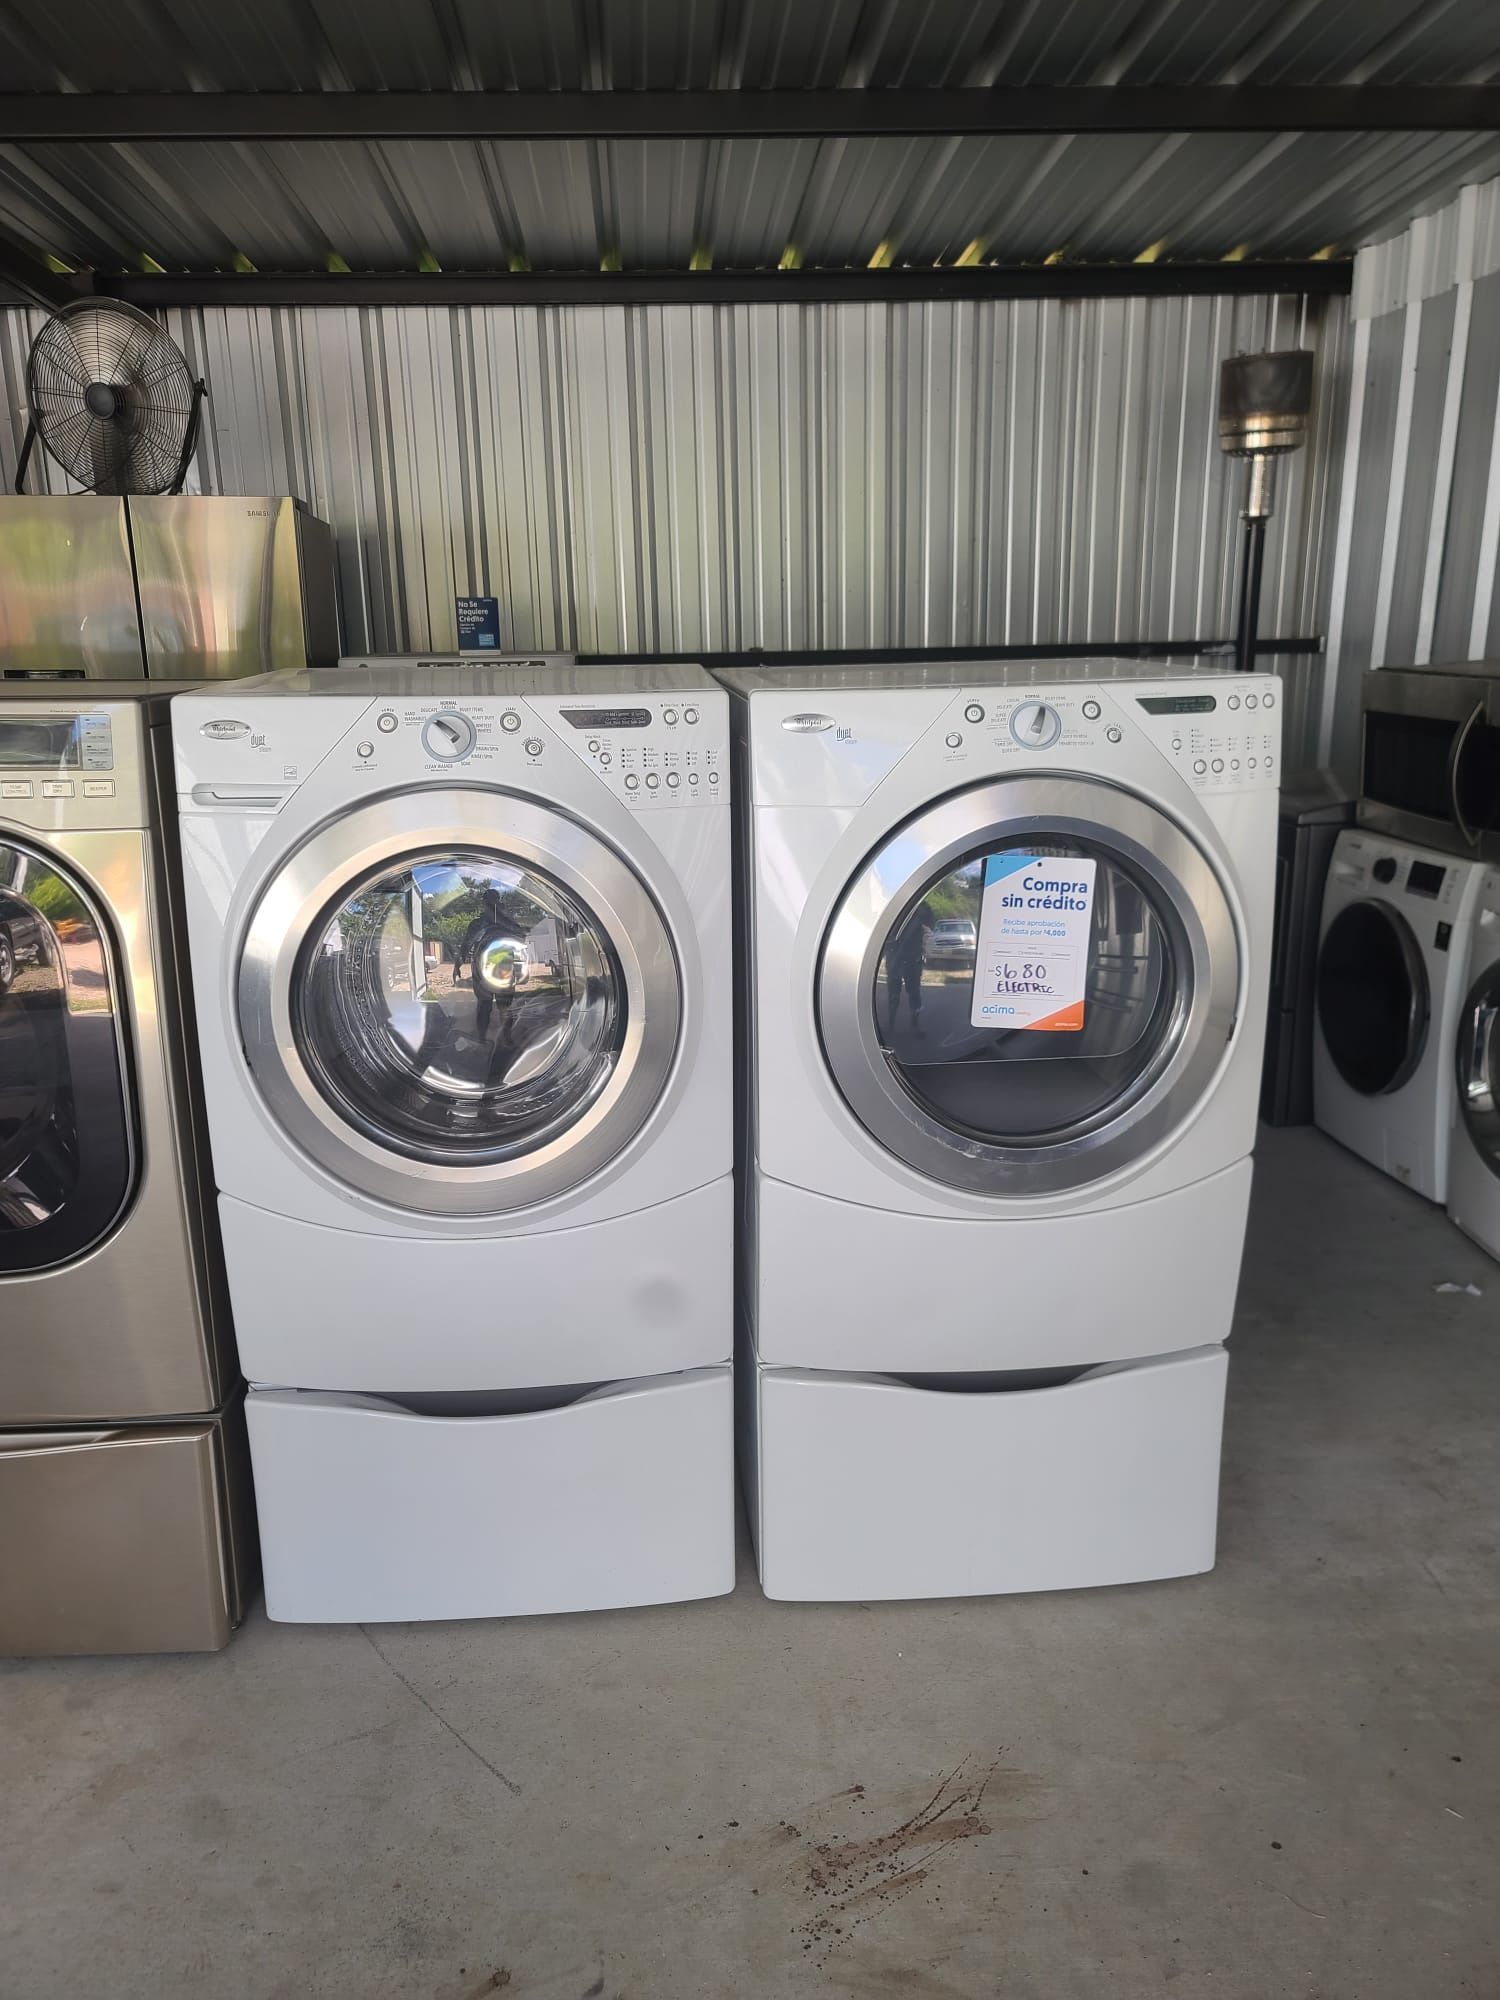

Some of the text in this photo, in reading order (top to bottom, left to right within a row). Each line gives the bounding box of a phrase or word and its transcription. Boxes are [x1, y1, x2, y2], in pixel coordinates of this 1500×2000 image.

[469, 600, 478, 608] Se
[458, 608, 489, 616] Requiere
[250, 733, 266, 747] duet
[836, 727, 852, 740] duet
[1023, 877, 1088, 895] Compra
[1001, 893, 1086, 911] sin crédito
[1026, 919, 1065, 928] aprobación
[997, 981, 1055, 994] ELECTRIC
[982, 1004, 1015, 1015] acima
